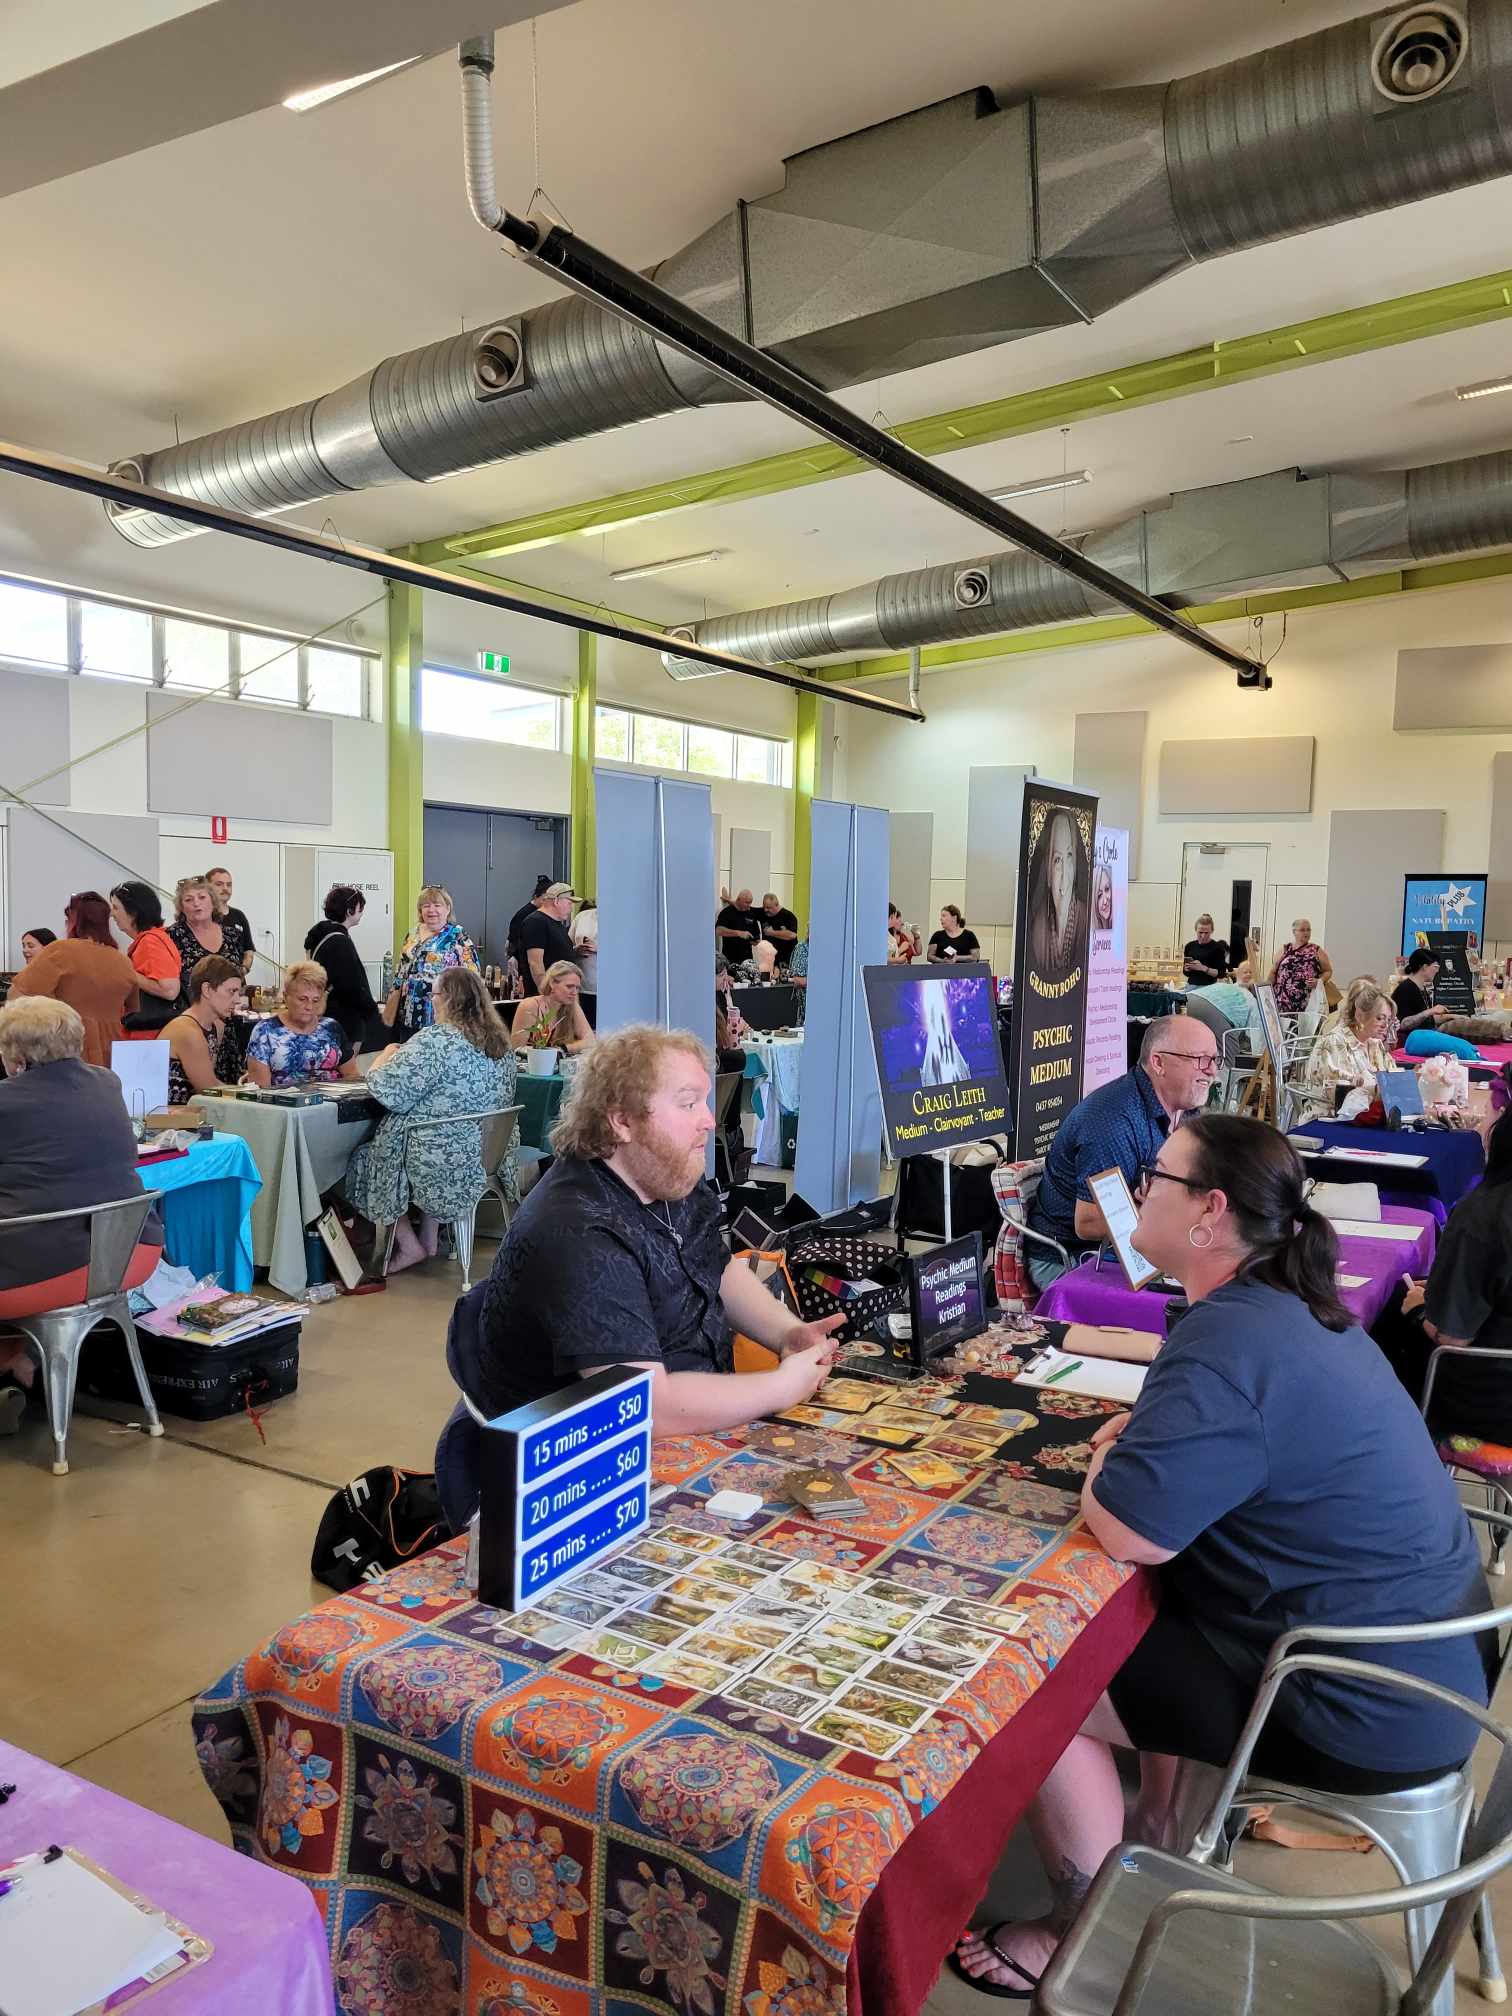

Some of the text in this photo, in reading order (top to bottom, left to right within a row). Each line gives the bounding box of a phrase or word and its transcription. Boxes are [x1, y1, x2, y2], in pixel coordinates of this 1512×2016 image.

[1029, 966, 1081, 998] GRANNY BOHO
[1032, 1024, 1073, 1050] PSYCHIC
[1030, 1058, 1072, 1086] MEDIUM
[912, 1085, 986, 1116] CRAIG LEITH
[896, 1123, 929, 1141] Medium
[934, 1114, 975, 1133] Clairvoyant
[978, 1107, 1005, 1123] Teacher
[921, 1256, 976, 1290] Psychic Medium
[935, 1281, 967, 1304] Readings
[939, 1302, 966, 1325] Kristian
[533, 1440, 550, 1467] 15
[555, 1425, 588, 1457] mins
[618, 1394, 641, 1425] $50
[530, 1496, 549, 1526] 20
[553, 1478, 587, 1510] mins
[616, 1446, 640, 1478] $60
[530, 1552, 548, 1582] 25
[552, 1533, 586, 1568] mins
[615, 1497, 639, 1530] $70
